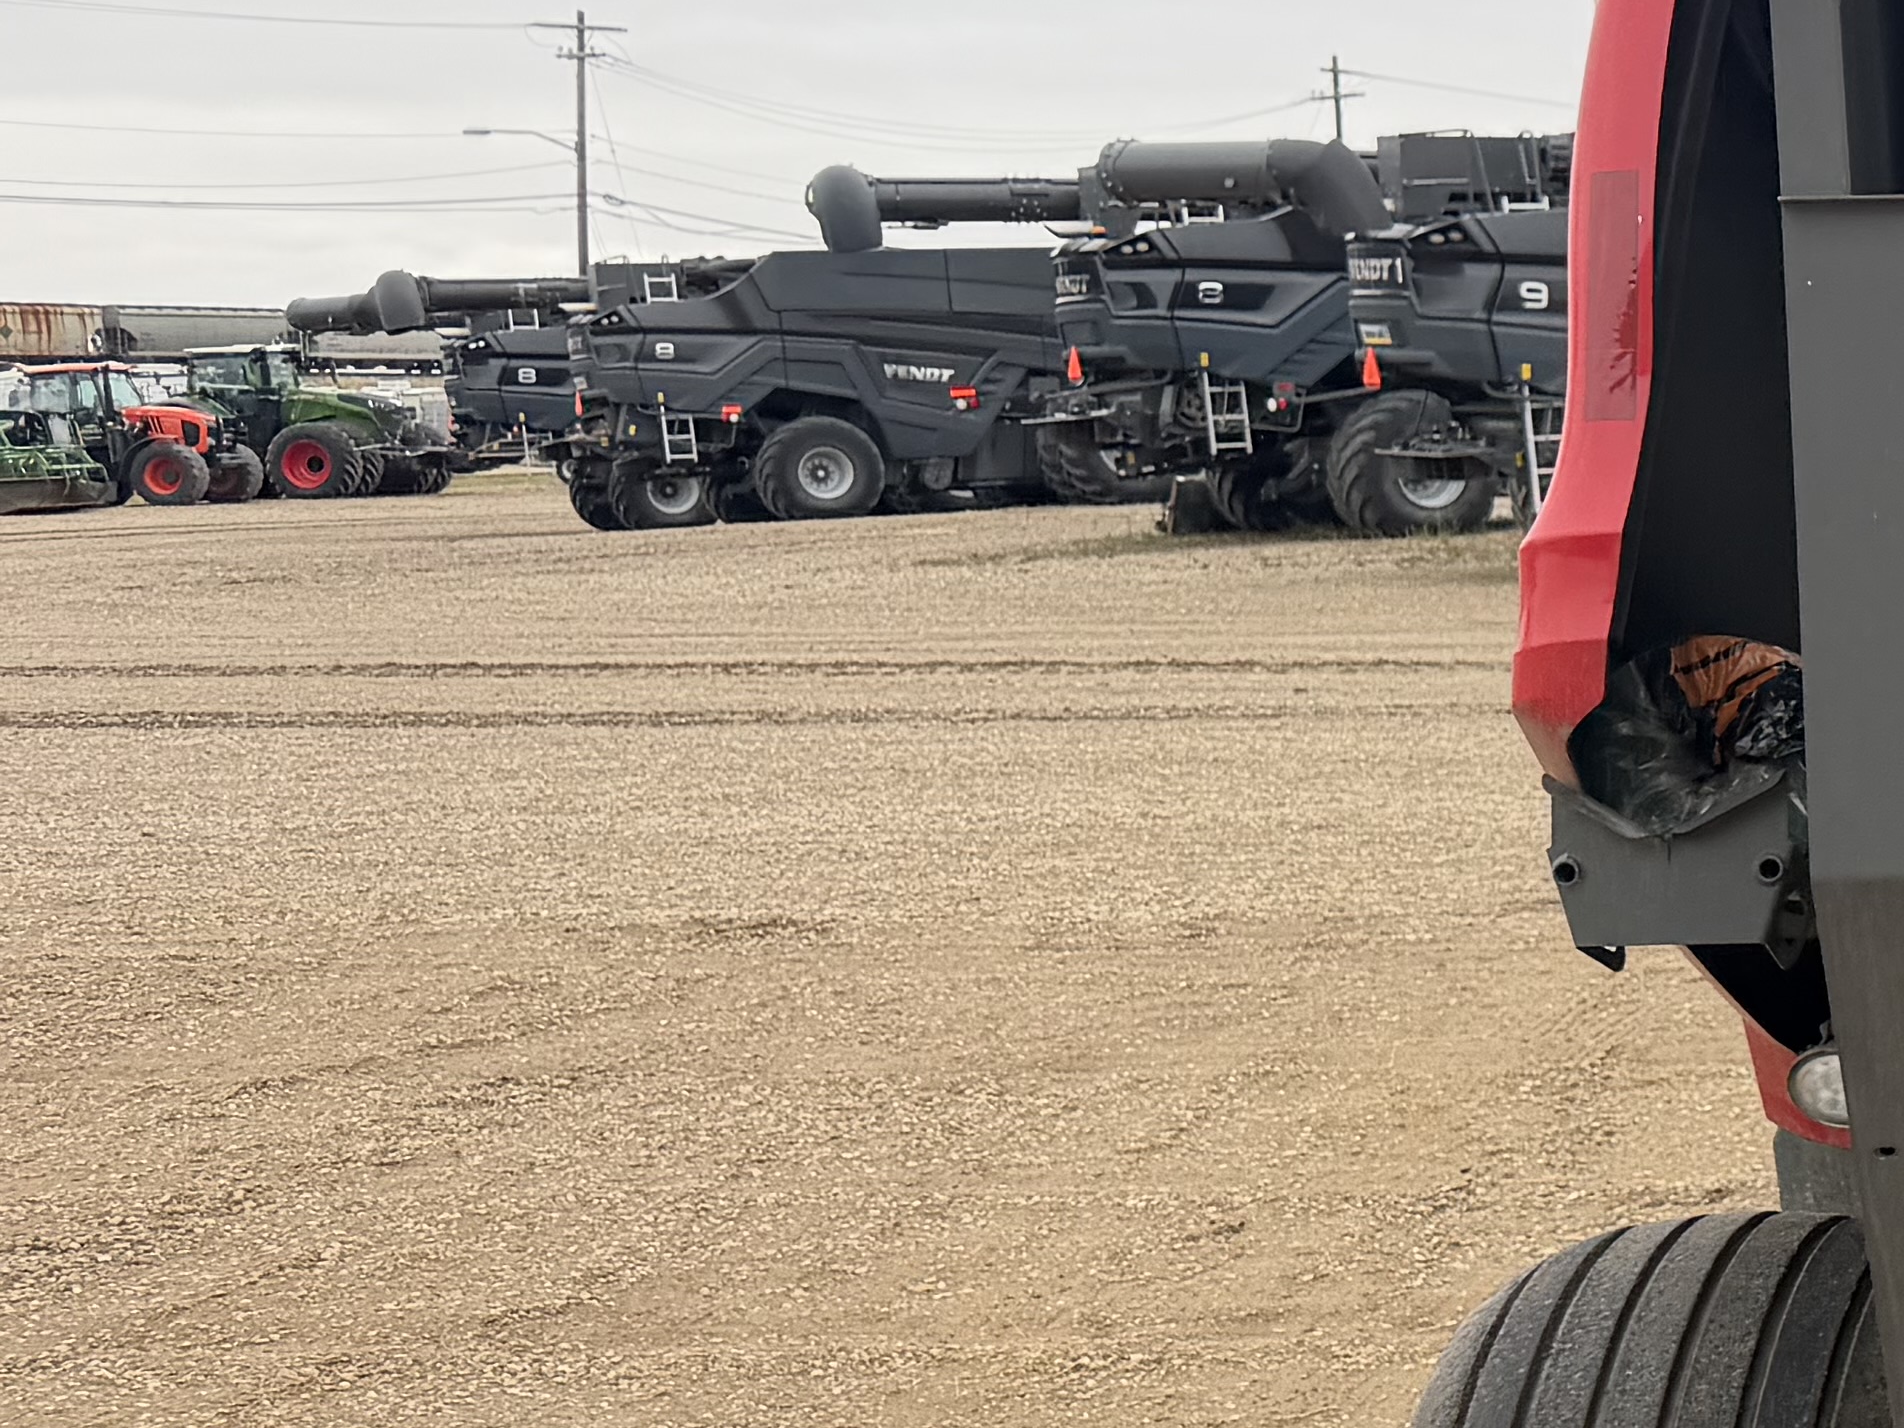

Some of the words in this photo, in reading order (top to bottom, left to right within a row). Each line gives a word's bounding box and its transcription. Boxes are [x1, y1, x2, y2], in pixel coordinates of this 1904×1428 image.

[1519, 281, 1549, 309] 9
[655, 342, 675, 359] 8
[518, 368, 537, 383] 8
